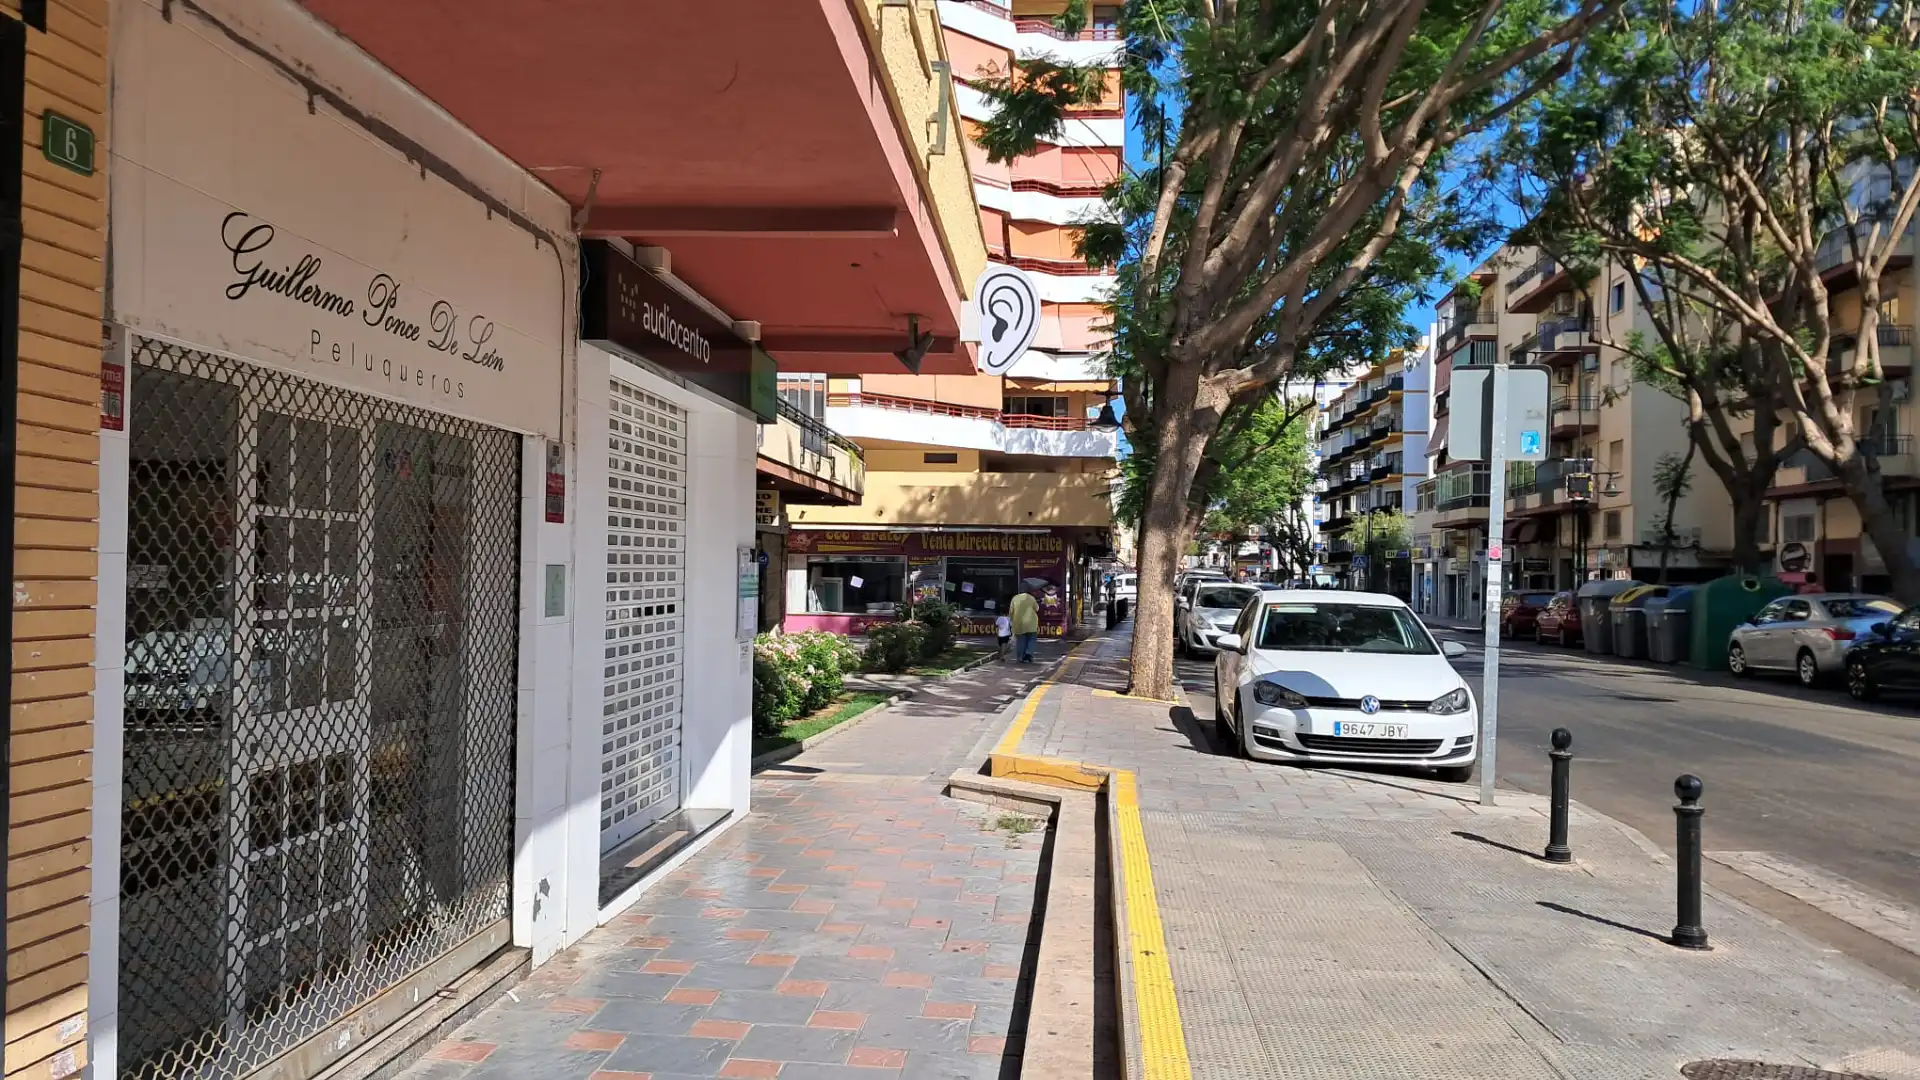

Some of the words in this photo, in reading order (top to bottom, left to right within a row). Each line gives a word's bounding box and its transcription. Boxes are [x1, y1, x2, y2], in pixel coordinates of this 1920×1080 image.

[65, 127, 77, 162] 6
[221, 211, 354, 300] Guillermo
[362, 273, 420, 342] Ponce
[427, 300, 458, 356] De
[462, 314, 504, 372] León
[642, 301, 710, 364] audiocentro
[310, 328, 465, 399] Peluqueros
[920, 532, 955, 550] Venta
[955, 532, 1000, 551] Directa
[1000, 532, 1017, 551] de
[1342, 723, 1375, 736] 9647
[1380, 725, 1404, 737] JBY
